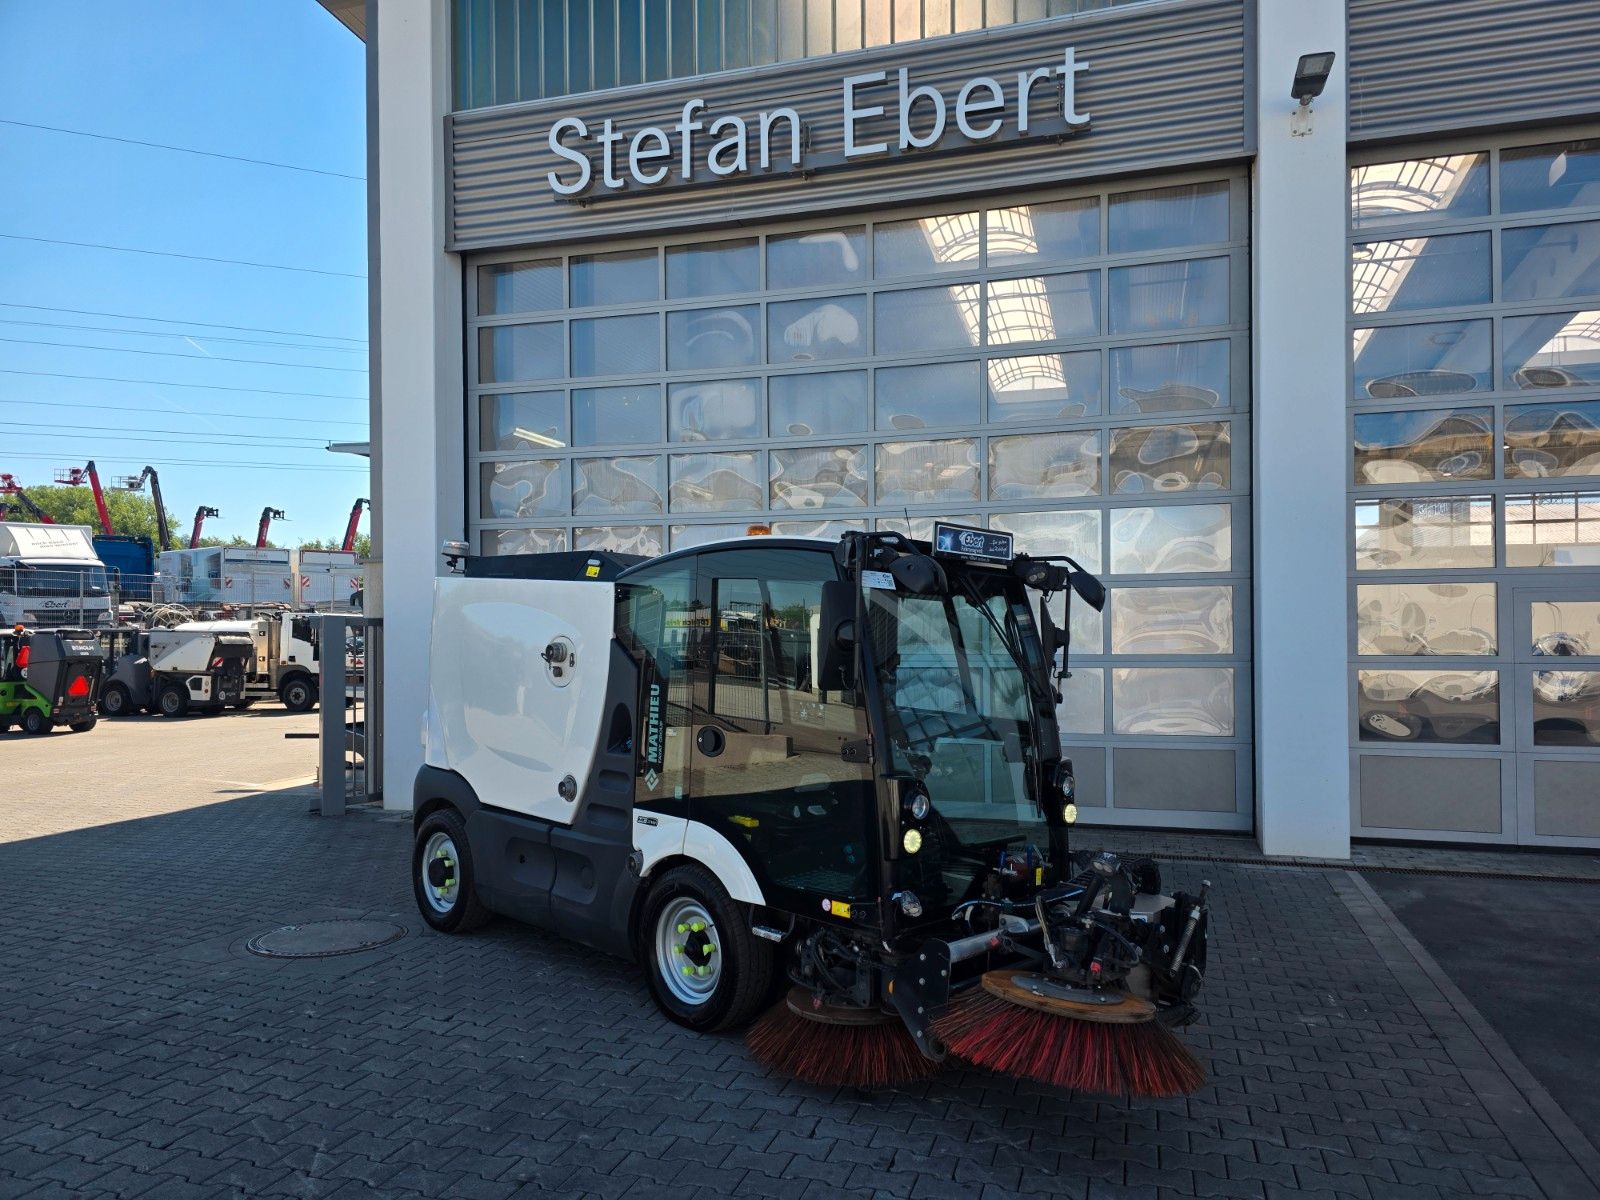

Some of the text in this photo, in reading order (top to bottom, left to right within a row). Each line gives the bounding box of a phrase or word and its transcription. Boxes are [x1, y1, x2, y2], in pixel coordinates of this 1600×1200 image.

[547, 46, 1092, 195] Stefan Ebert
[42, 600, 70, 609] Ebert
[647, 684, 660, 764] MATHIEU
